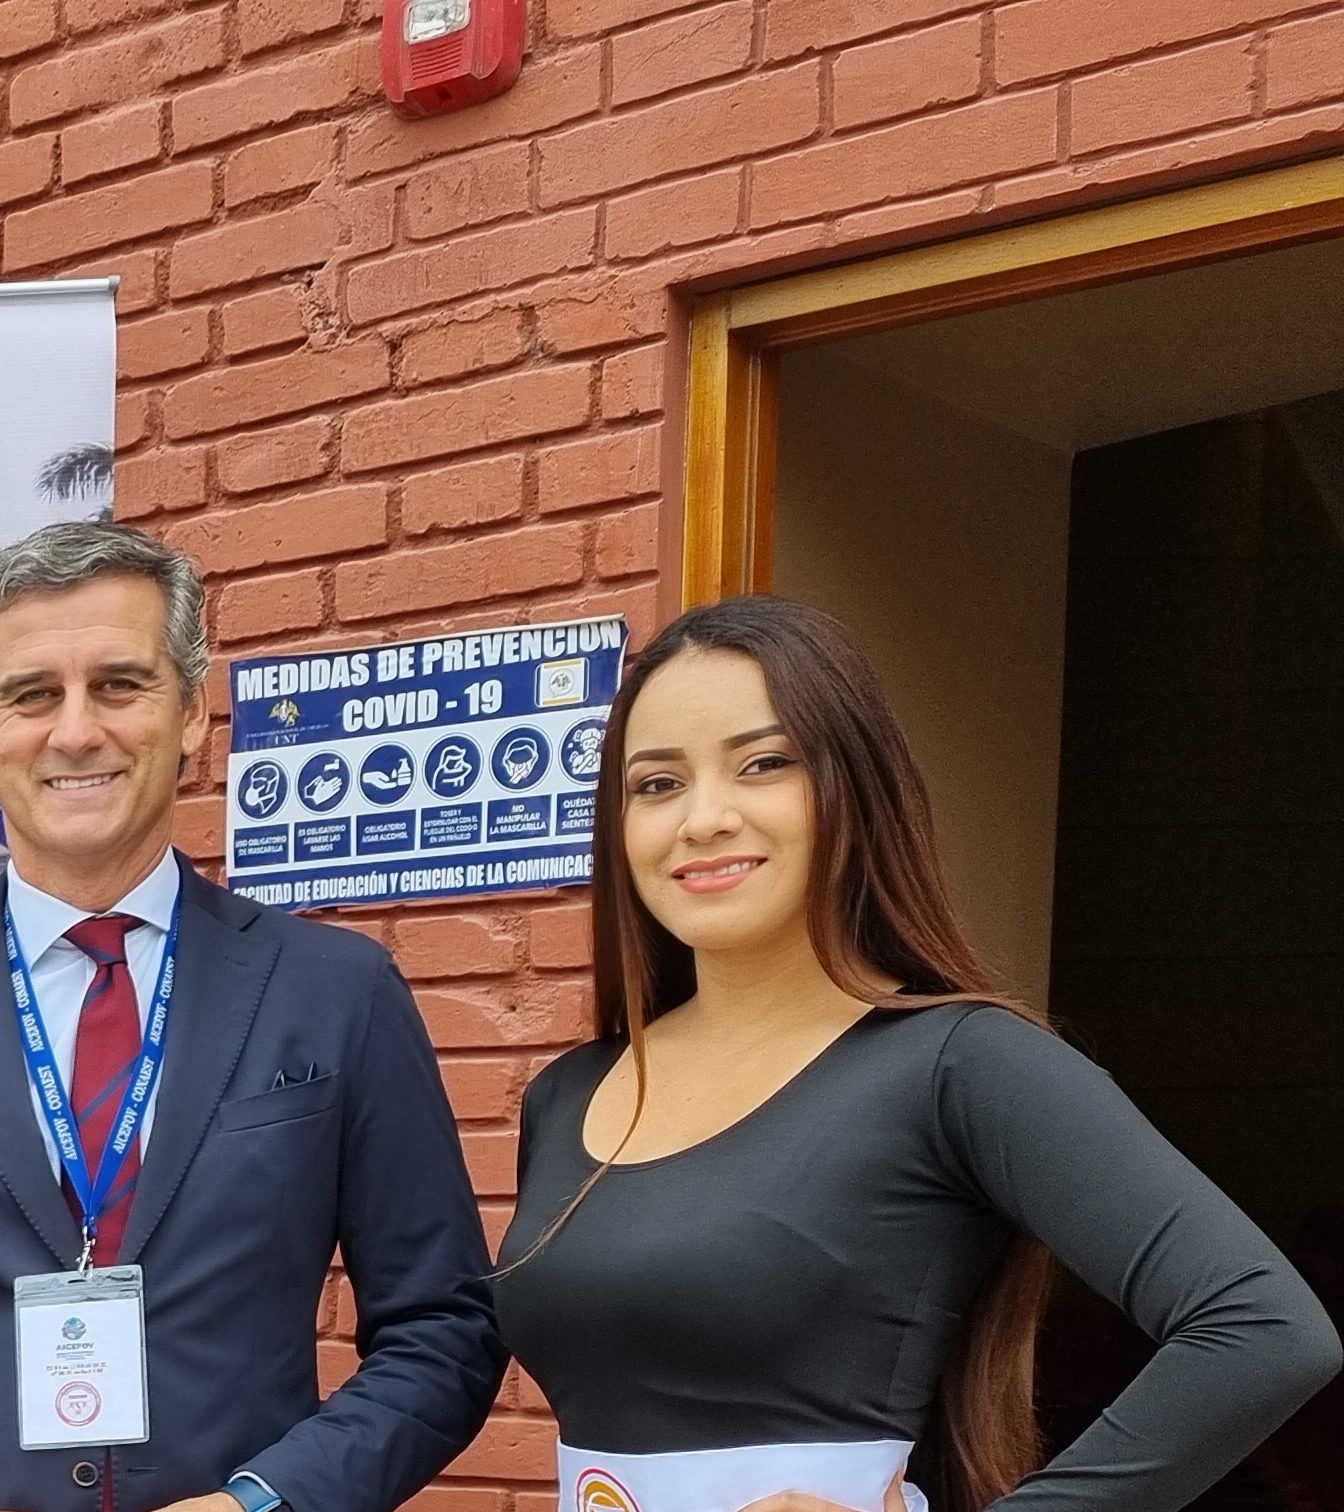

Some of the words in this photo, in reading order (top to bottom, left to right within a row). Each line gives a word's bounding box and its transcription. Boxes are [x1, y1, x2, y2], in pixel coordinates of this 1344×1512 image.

[238, 653, 370, 702] MEDIDAS
[377, 646, 416, 682] DE
[343, 689, 439, 732] COVID
[445, 700, 458, 709] -
[464, 679, 503, 716] 19
[496, 813, 541, 824] MANIPULAR
[500, 822, 547, 834] MASCARILLA
[512, 804, 525, 813] NO
[568, 808, 590, 818] CASA
[294, 880, 312, 902] DE
[313, 870, 388, 901] EDUCACIÓN
[389, 872, 399, 894] Y
[400, 866, 465, 893] CIENCIAS
[466, 864, 485, 886] DE
[486, 862, 504, 884] LA
[37, 1065, 62, 1110] CONAEST
[113, 1106, 139, 1154] AICEFOV
[133, 1055, 156, 1102] CONAEST
[53, 1116, 78, 1161] AICEFOV
